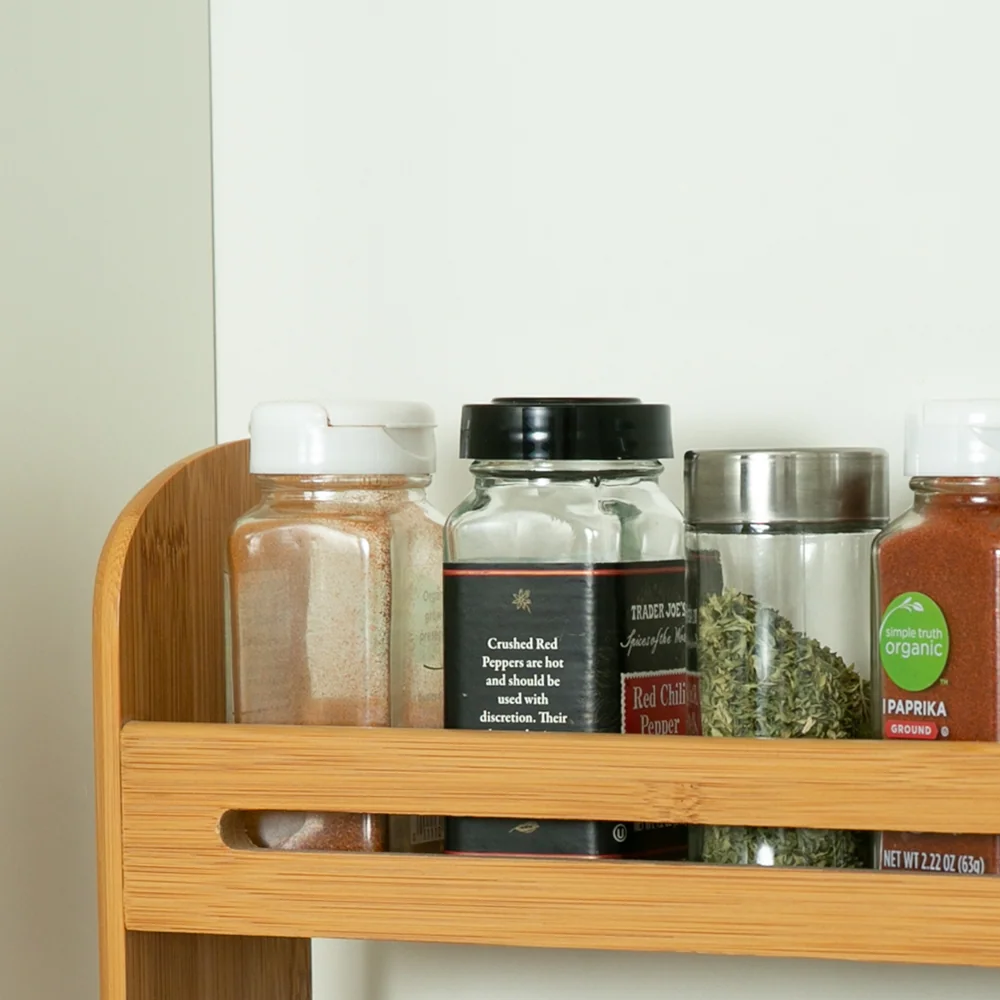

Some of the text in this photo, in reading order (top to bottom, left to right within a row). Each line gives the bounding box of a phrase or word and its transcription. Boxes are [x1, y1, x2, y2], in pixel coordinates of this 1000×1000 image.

[631, 601, 687, 621] TRADER JOE'S
[885, 626, 943, 640] simple truth
[487, 637, 558, 650] Crushed Red
[620, 629, 651, 656] Spices
[885, 640, 943, 658] organic
[482, 656, 564, 671] Peppers are hot
[486, 674, 560, 686] and should be
[498, 693, 549, 705] used with
[632, 682, 686, 710] Red Chili
[887, 699, 947, 717] PAPRIKA
[479, 711, 568, 723] discretion. Their
[640, 714, 681, 734] Pepper
[890, 724, 932, 735] GROUND
[884, 850, 985, 875] NET WT 2.22 OZ (63g)
